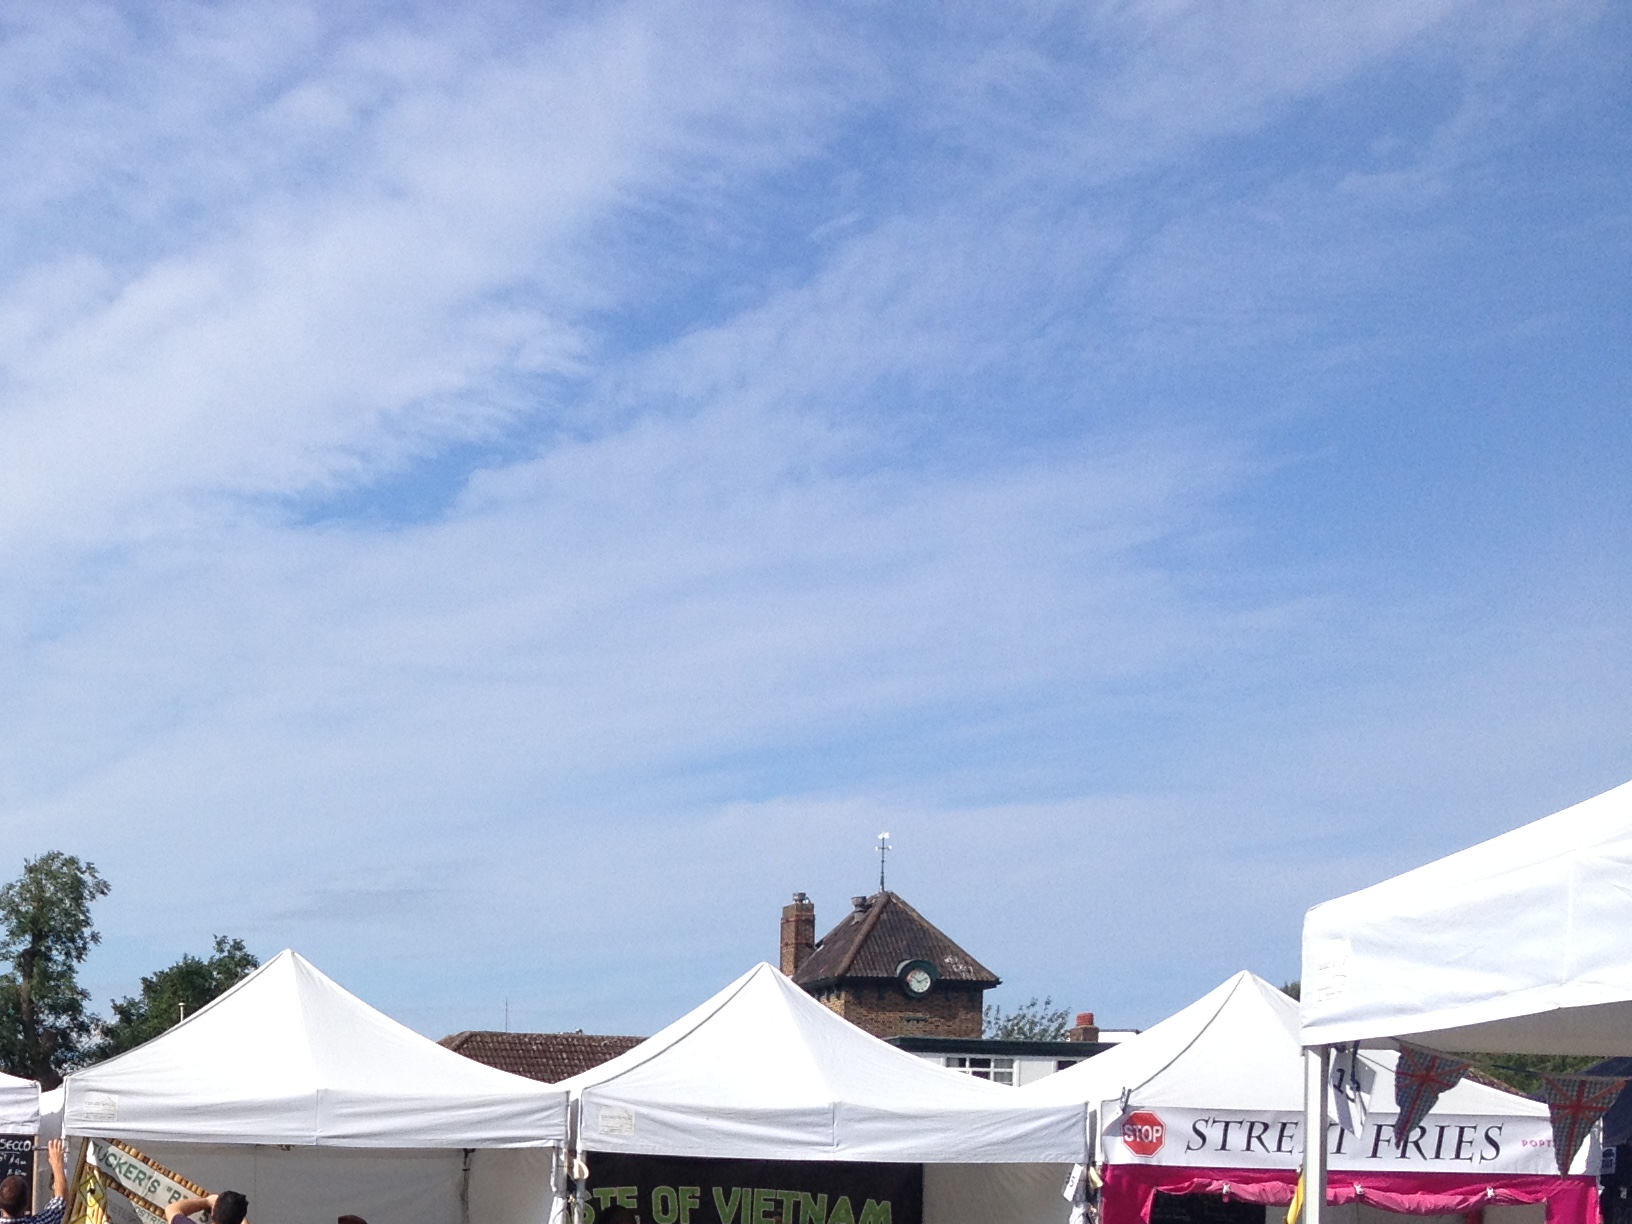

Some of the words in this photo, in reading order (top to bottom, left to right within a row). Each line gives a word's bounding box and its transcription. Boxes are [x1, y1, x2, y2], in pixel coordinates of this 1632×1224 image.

[1123, 1125, 1162, 1143] STOP
[1185, 1116, 1346, 1155] STRET
[1366, 1123, 1504, 1164] FRIES
[1521, 1139, 1555, 1149] POPT
[92, 1142, 161, 1194] TUCKER'S
